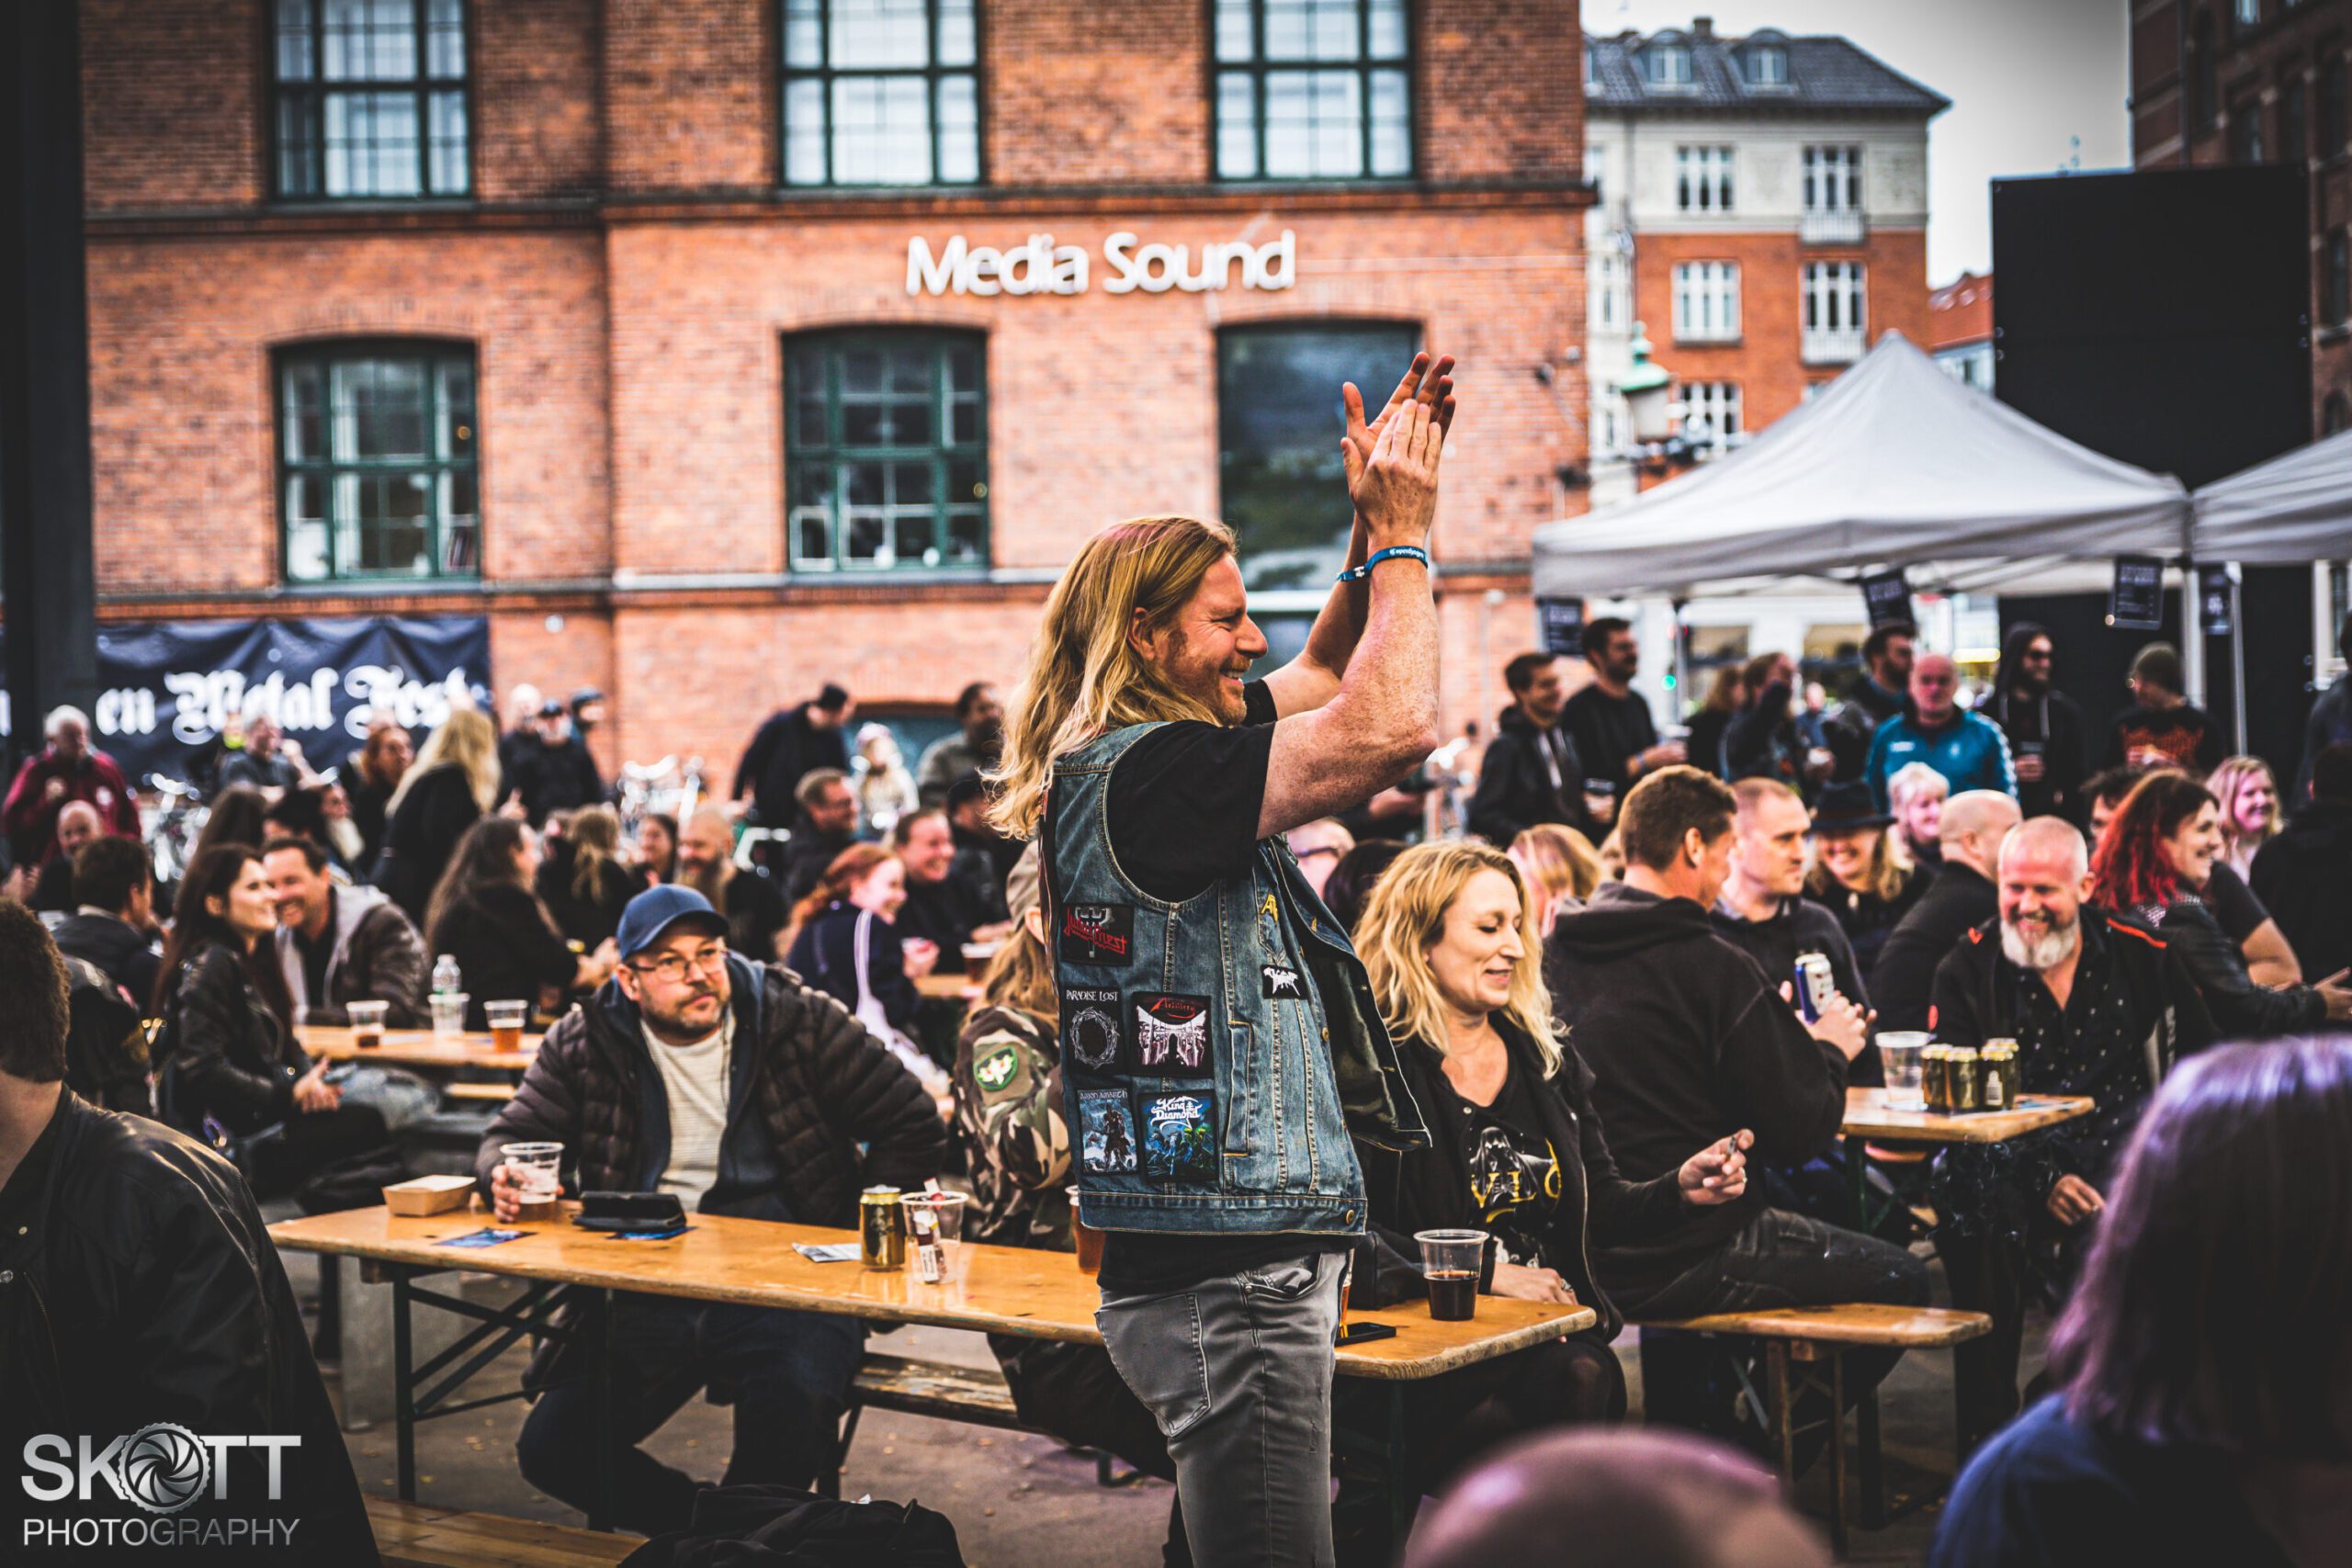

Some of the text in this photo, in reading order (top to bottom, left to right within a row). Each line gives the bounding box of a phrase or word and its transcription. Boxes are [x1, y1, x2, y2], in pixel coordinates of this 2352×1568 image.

[905, 229, 1295, 296] Media Sound
[164, 668, 340, 745] Metal
[1066, 989, 1118, 1002] PARADISE LOST
[1150, 1106, 1203, 1122] Diamond
